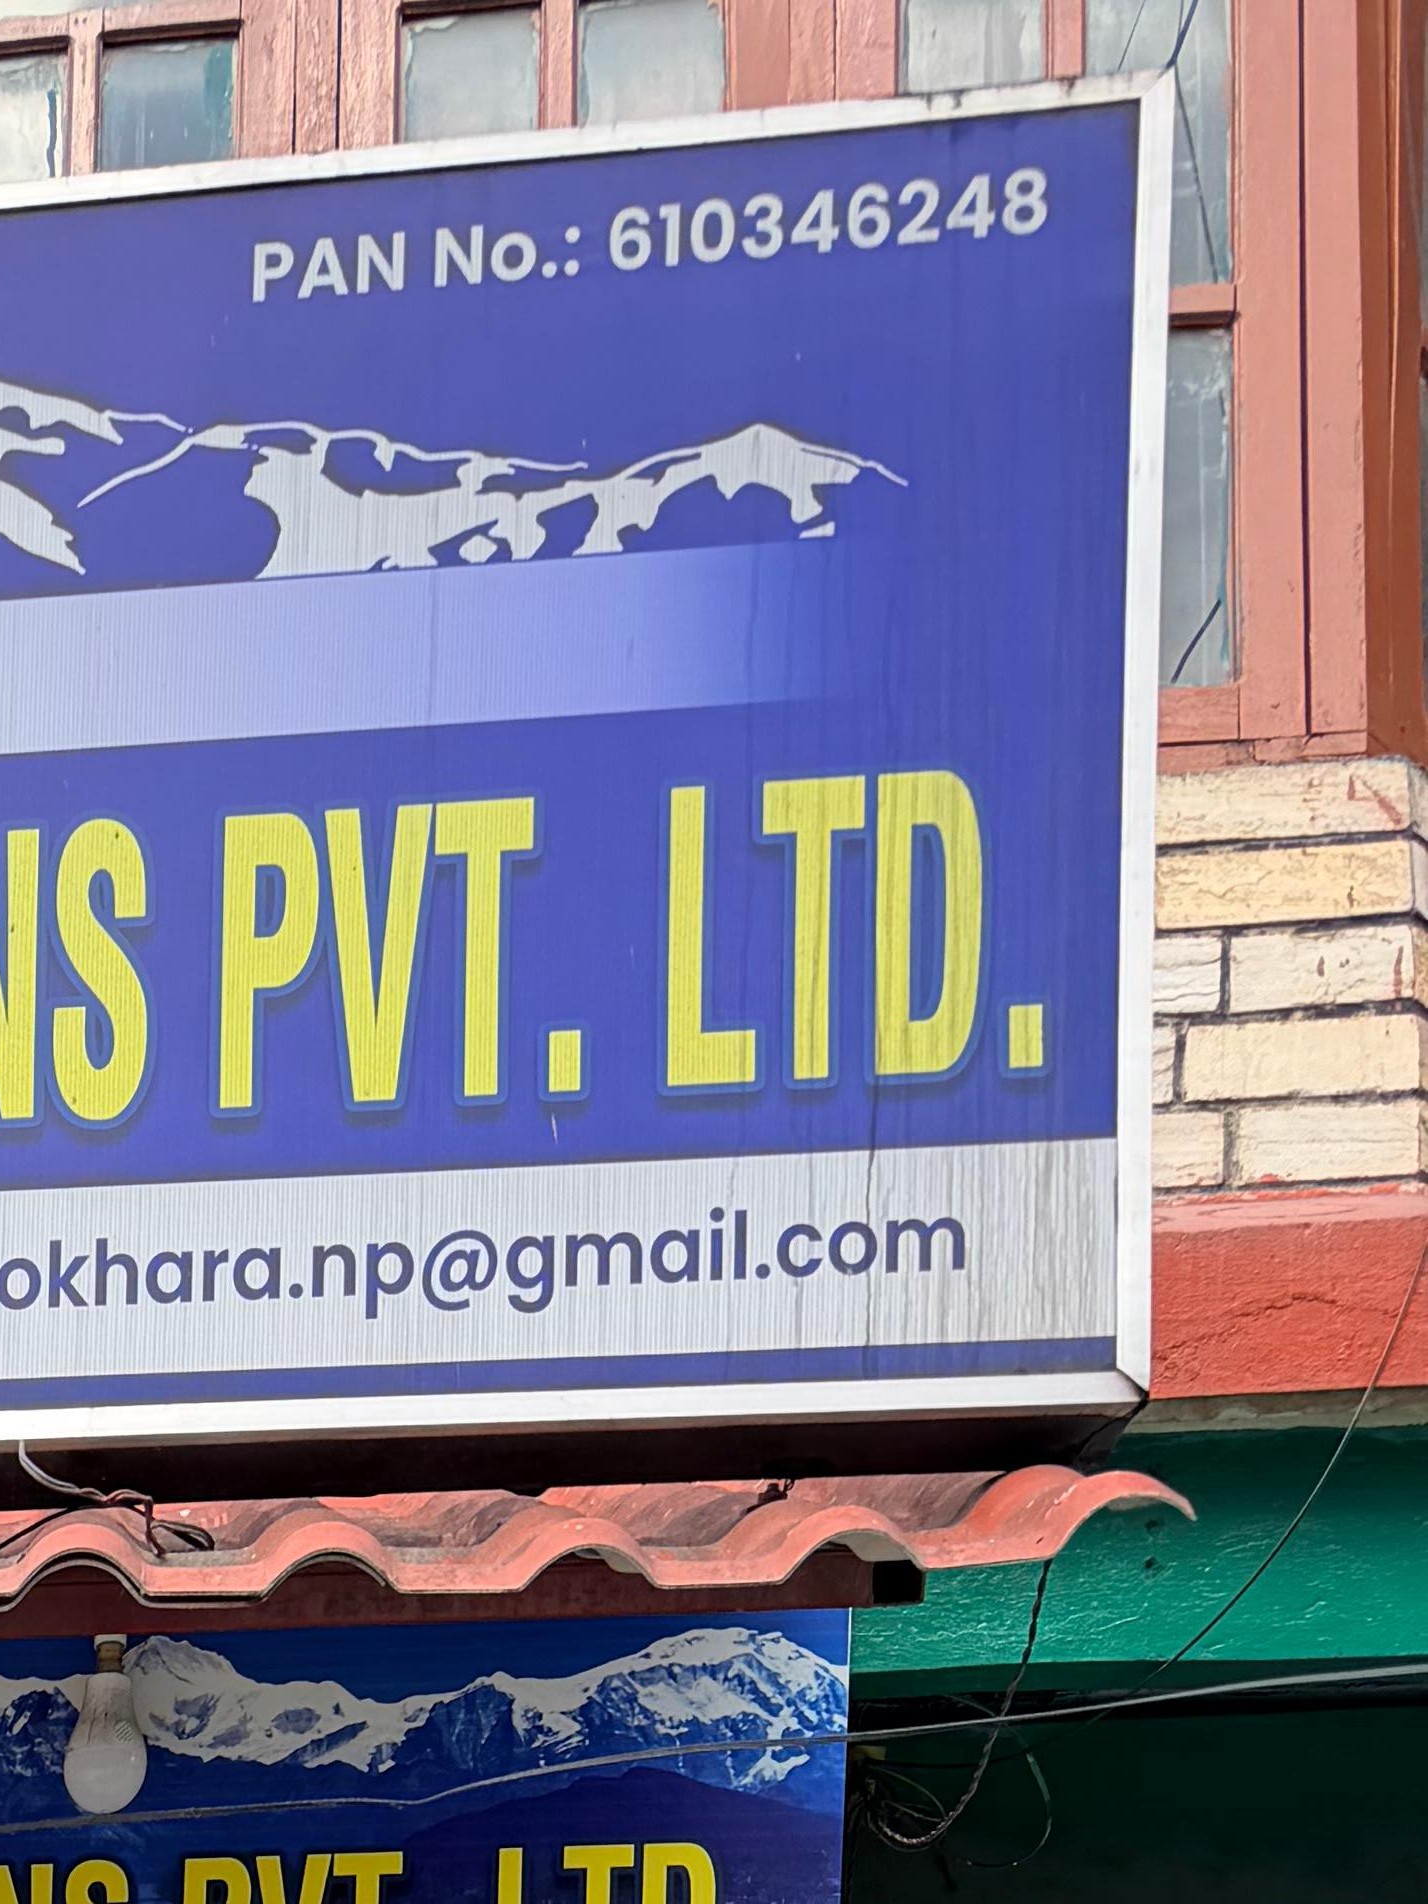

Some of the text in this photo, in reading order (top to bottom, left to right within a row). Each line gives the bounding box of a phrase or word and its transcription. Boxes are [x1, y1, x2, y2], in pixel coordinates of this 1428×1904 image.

[250, 167, 1050, 303] PAN No.: 610346248
[216, 797, 586, 1112] PVT.
[664, 769, 1047, 1088] LTD.
